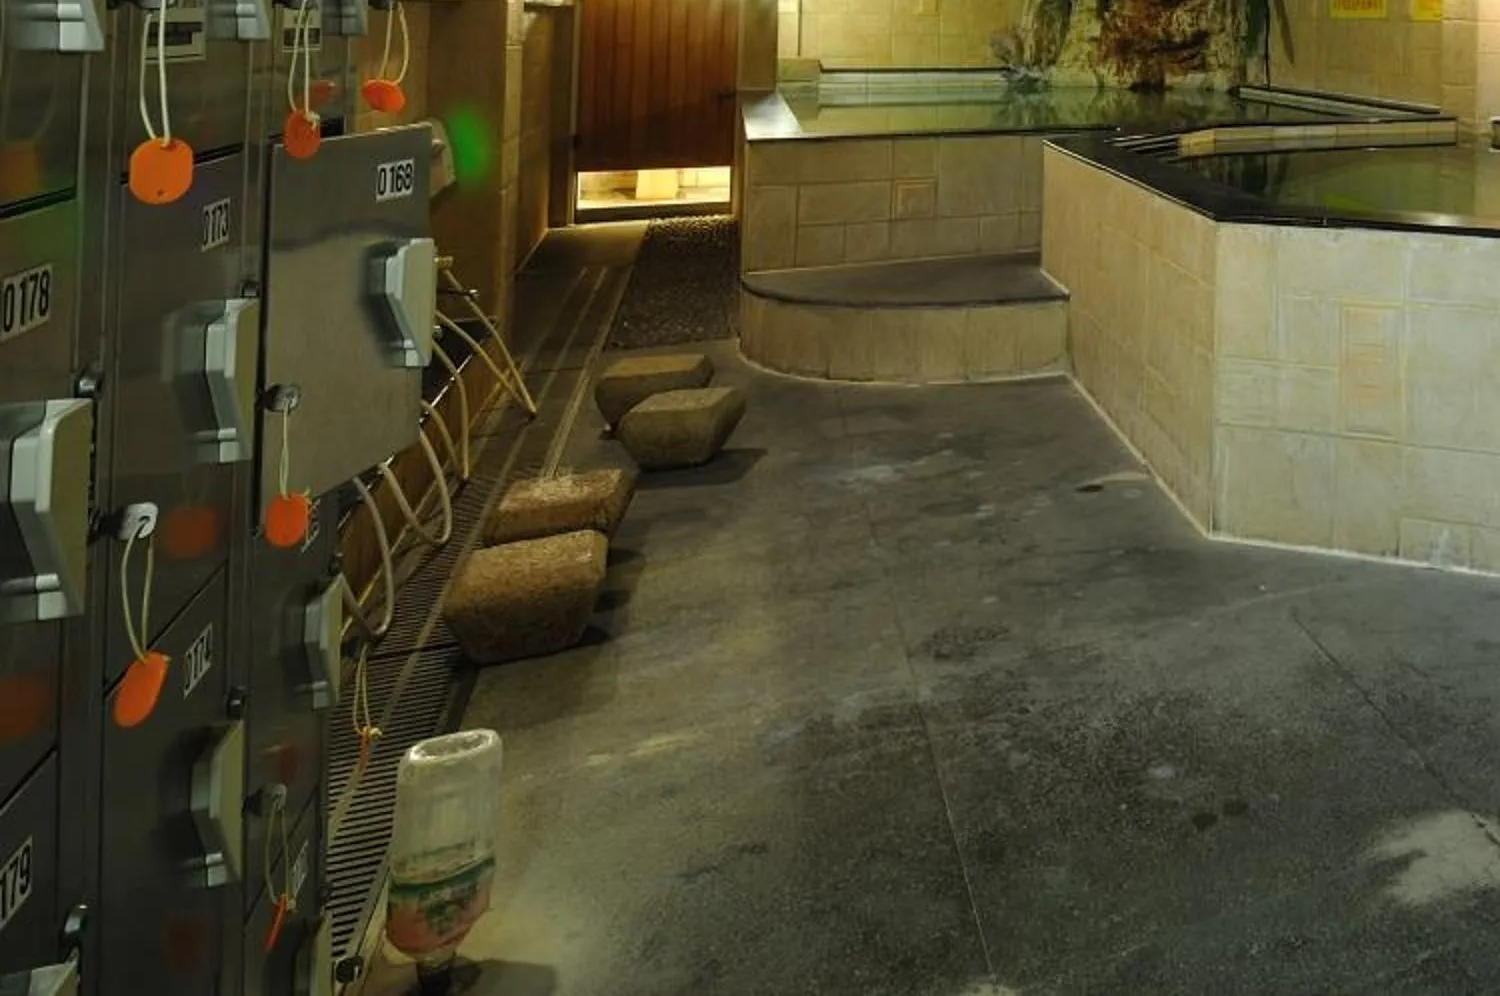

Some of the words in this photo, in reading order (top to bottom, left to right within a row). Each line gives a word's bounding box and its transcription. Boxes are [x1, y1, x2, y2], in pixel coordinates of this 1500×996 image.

[377, 162, 413, 196] 0168
[203, 203, 229, 246] 0173
[4, 270, 50, 333] 0178
